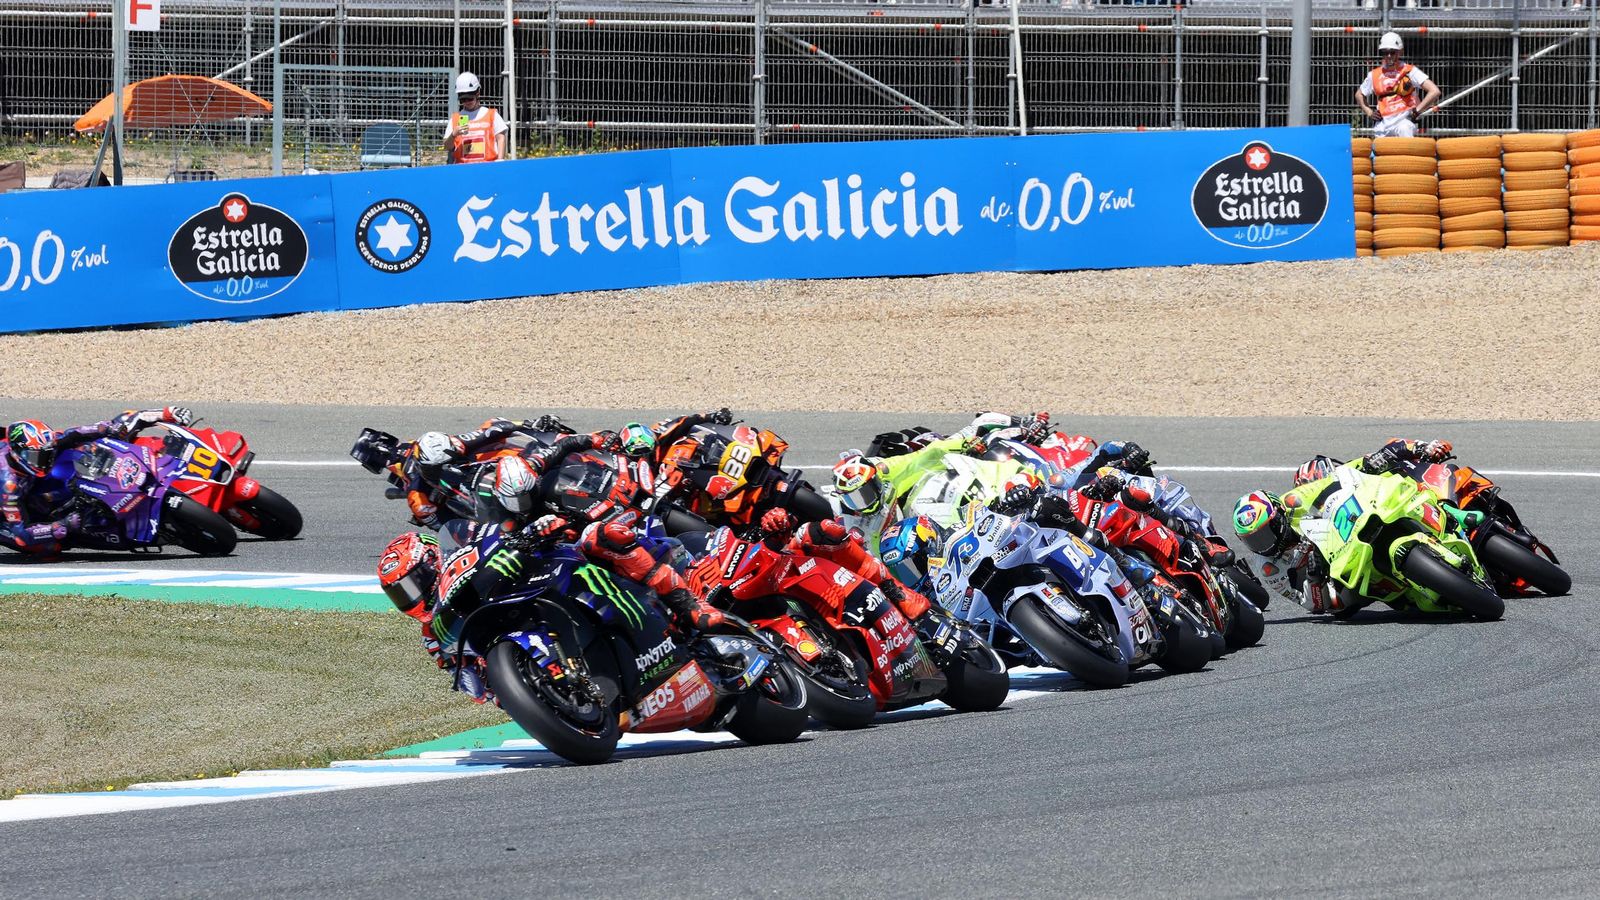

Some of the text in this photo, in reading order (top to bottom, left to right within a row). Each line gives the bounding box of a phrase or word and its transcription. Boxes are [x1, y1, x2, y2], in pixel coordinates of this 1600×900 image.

[1214, 172, 1304, 198] Estrella
[359, 203, 387, 229] ESTRELLA
[387, 201, 415, 215] GALICIA
[454, 186, 709, 261] Estrella
[725, 172, 962, 243] Galicia
[980, 196, 1013, 223] alc.
[1018, 172, 1094, 232] 0,0
[1218, 196, 1302, 222] Galicia
[192, 222, 283, 251] Estrella
[1246, 223, 1274, 243] 0,0
[196, 248, 281, 275] Galicia
[359, 241, 398, 271] CERVECEROS
[399, 253, 421, 270] DESDE
[226, 275, 253, 297] 0,0
[187, 447, 219, 481] 10
[722, 444, 751, 480] 33
[1088, 502, 1101, 529] enovo
[1333, 493, 1364, 544] 21
[723, 543, 746, 579] Lenovo
[635, 636, 677, 672] MONSTER
